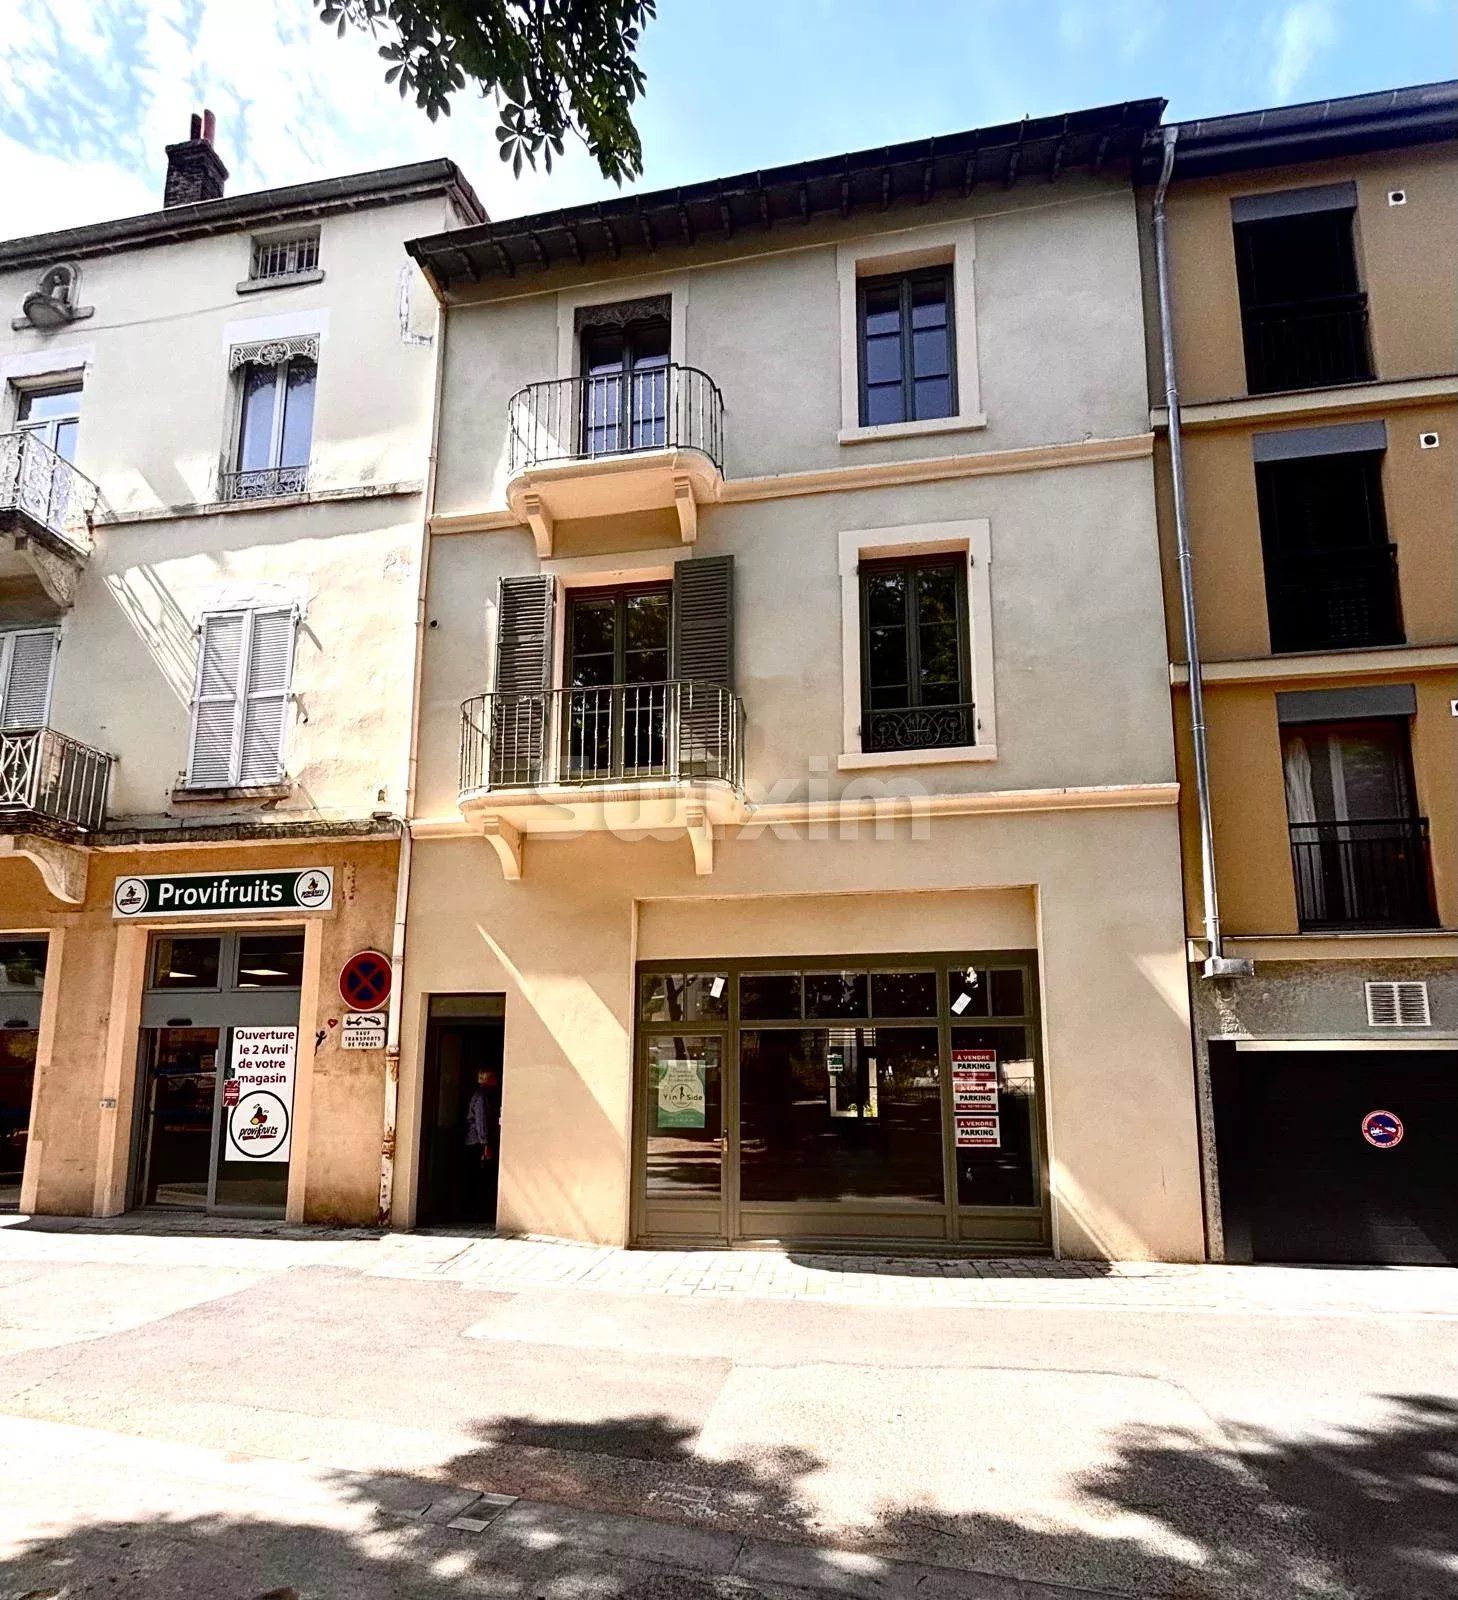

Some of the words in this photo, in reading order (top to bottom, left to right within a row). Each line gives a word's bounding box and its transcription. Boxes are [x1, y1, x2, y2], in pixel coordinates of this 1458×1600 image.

[158, 878, 283, 906] Provifruits
[235, 1030, 295, 1040] Ouverture
[239, 1044, 250, 1055] le
[252, 1045, 259, 1055] 2
[262, 1044, 289, 1055] Avril
[238, 1058, 253, 1069] de
[255, 1060, 286, 1069] votre
[238, 1073, 287, 1086] magasin
[686, 1093, 703, 1101] Side
